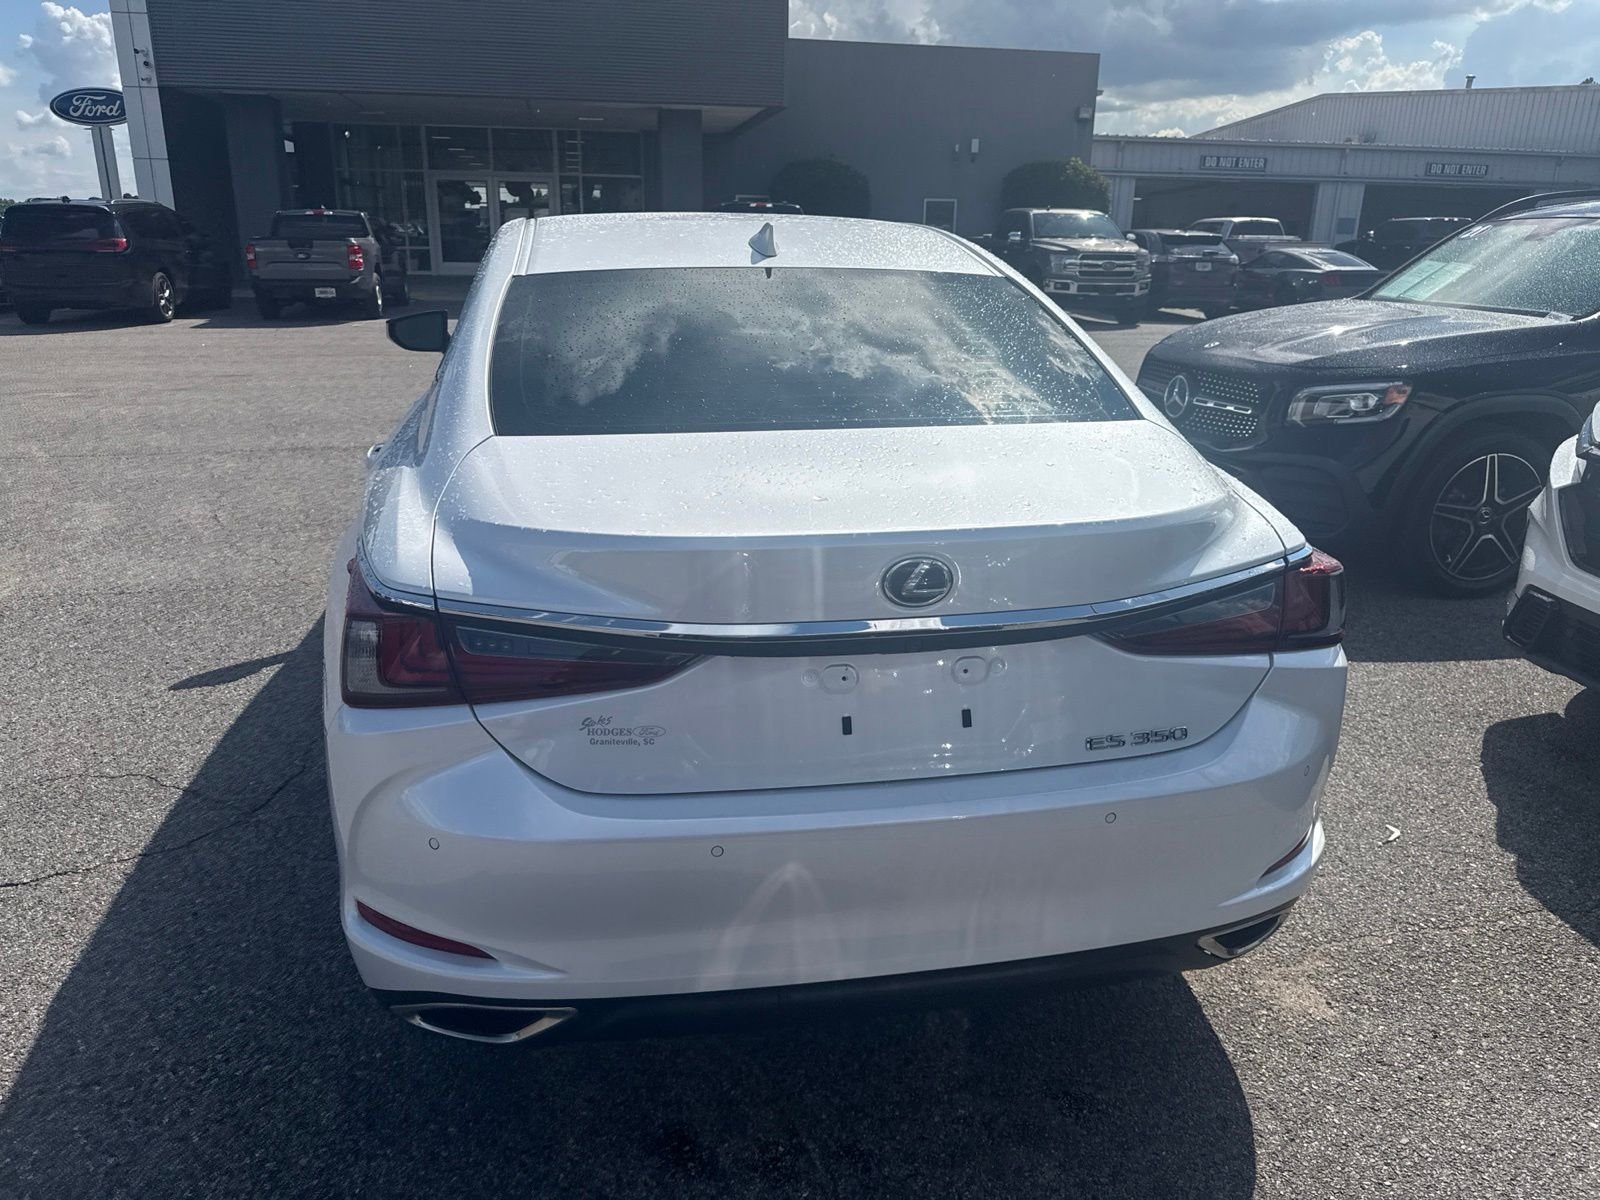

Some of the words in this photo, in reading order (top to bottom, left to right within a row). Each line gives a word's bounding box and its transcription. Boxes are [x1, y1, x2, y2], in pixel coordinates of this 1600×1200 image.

[69, 94, 121, 117] Ford
[1205, 156, 1217, 168] DO
[1219, 157, 1237, 168] NOT
[1238, 157, 1265, 169] ENTER
[1430, 163, 1442, 174] DO
[1443, 164, 1460, 175] NOT
[1461, 164, 1487, 175] ENTER
[587, 728, 633, 736] HODGES
[589, 738, 641, 747] Graniteville,
[643, 738, 655, 746] SC
[1085, 735, 1126, 751] ES
[1130, 726, 1188, 746] 350
